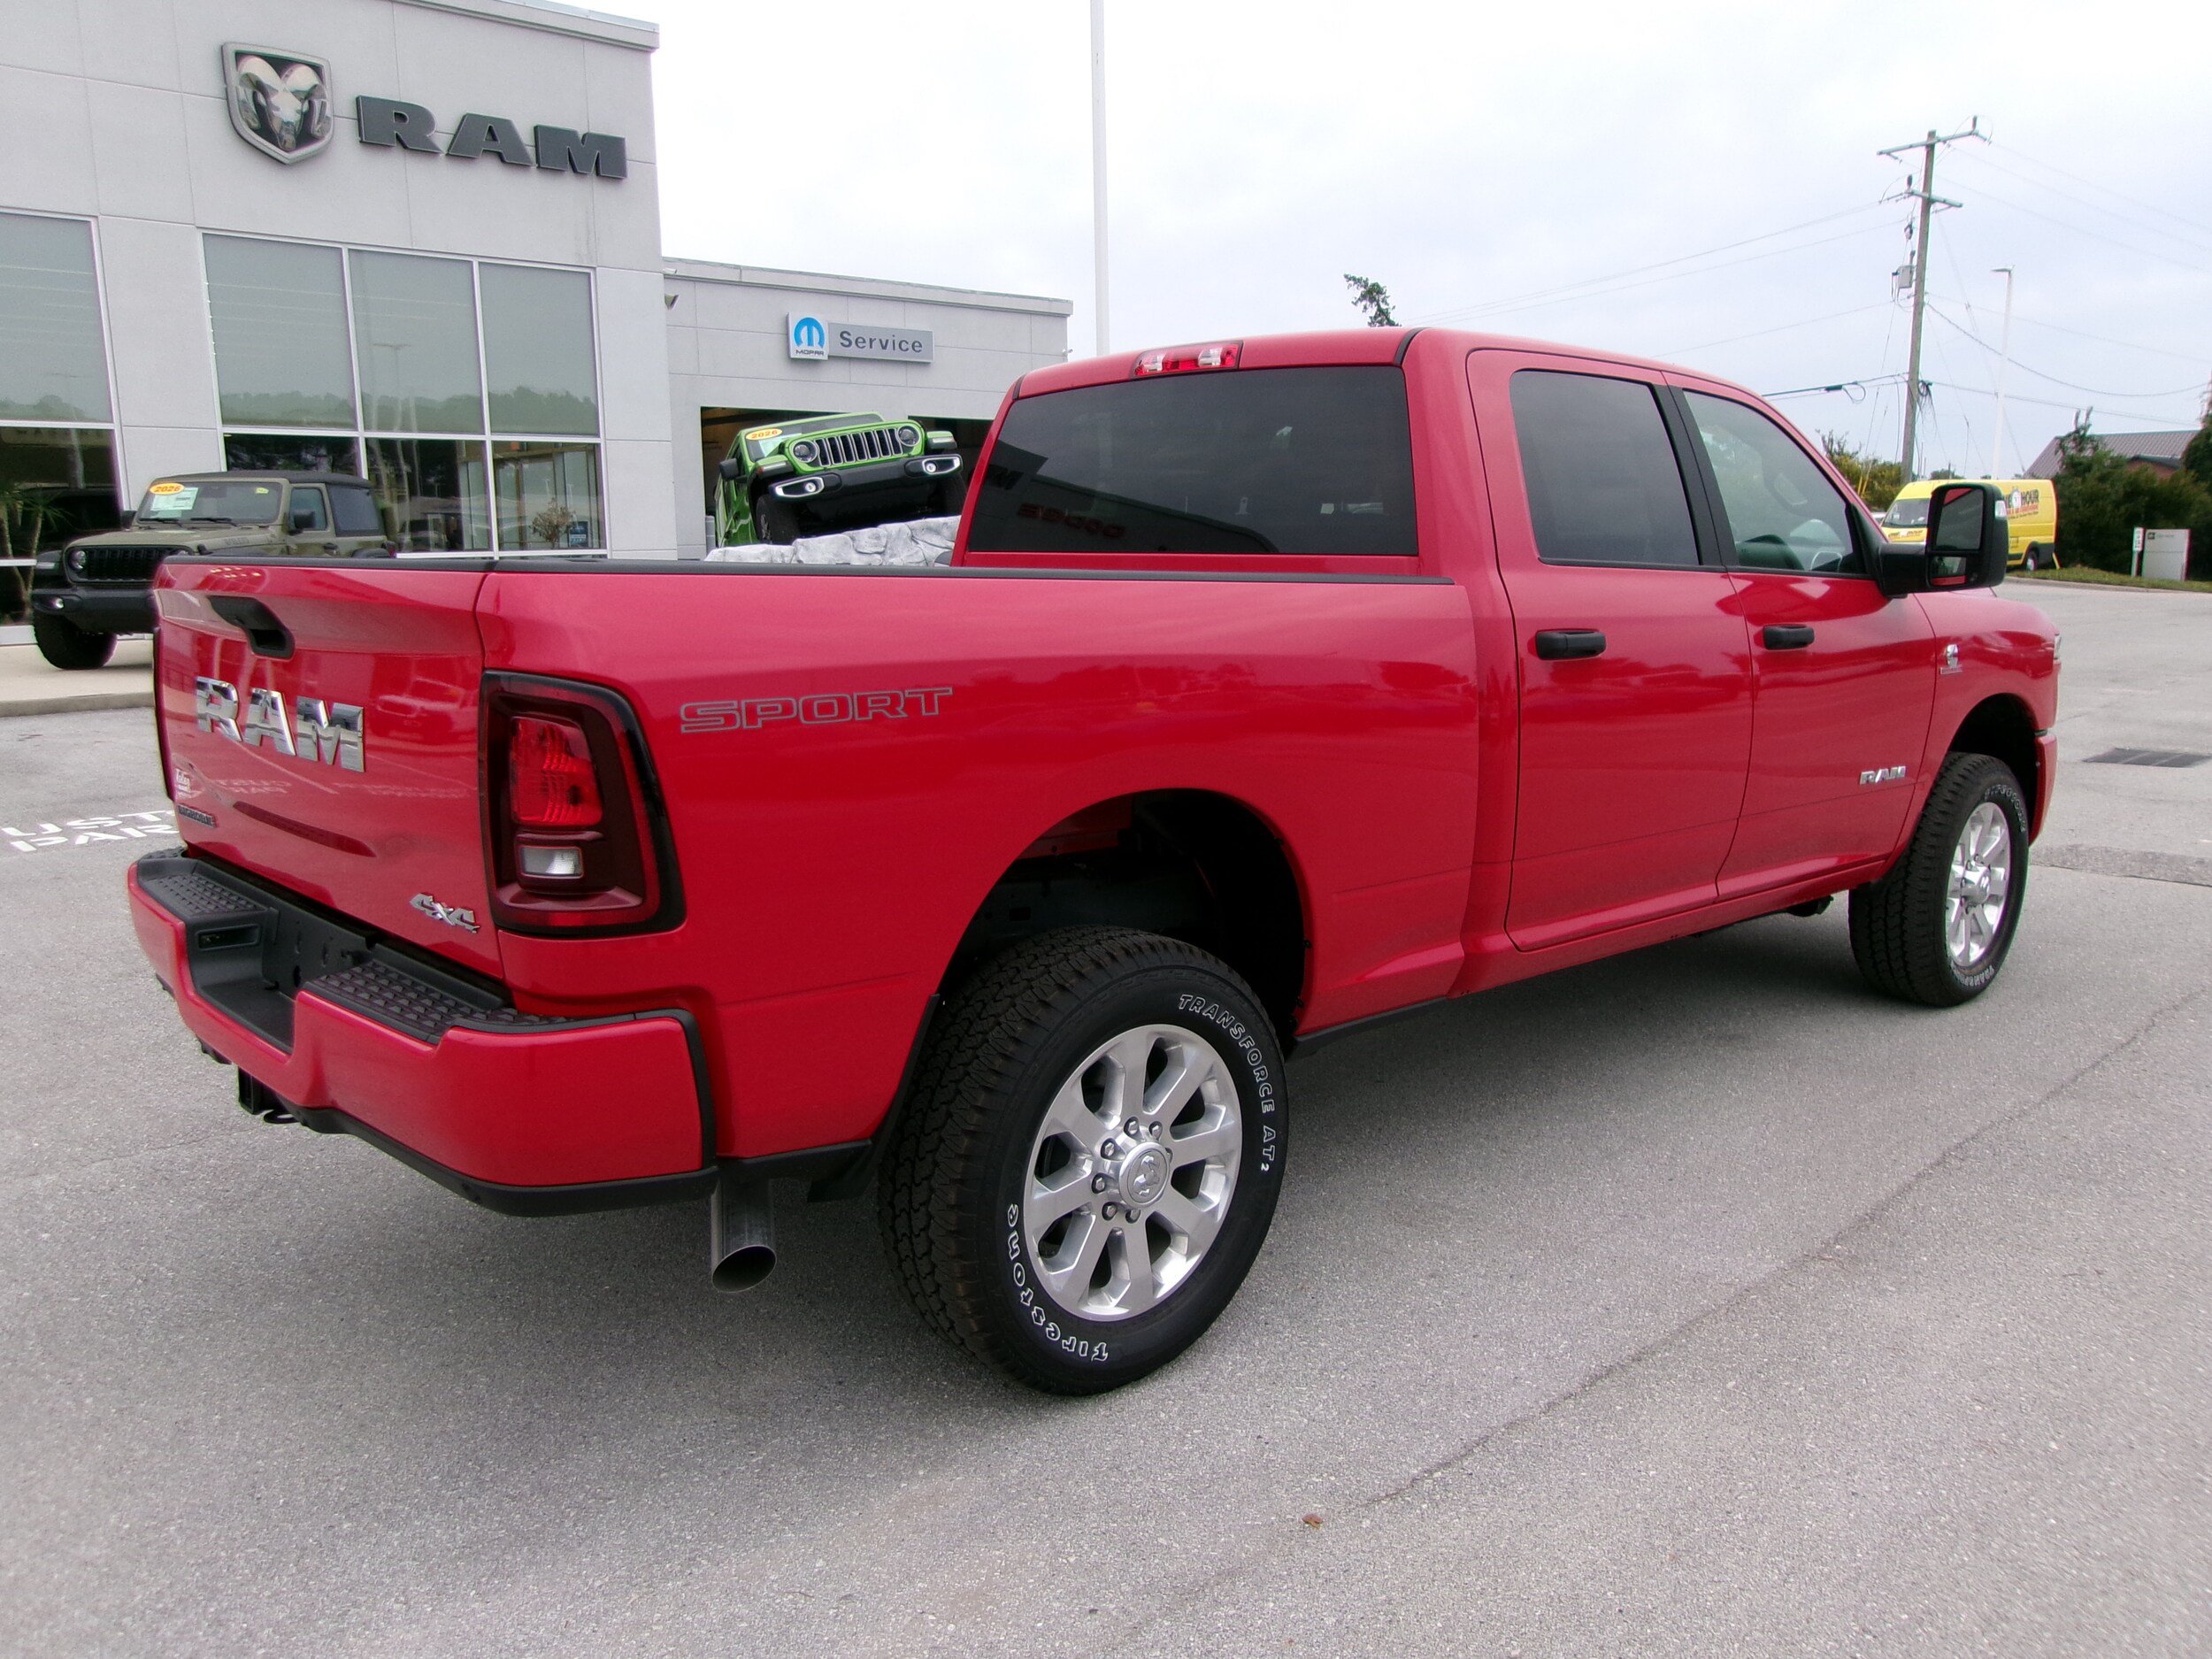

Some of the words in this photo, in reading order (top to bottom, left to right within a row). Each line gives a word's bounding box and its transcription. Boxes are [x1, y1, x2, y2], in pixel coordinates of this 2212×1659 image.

[356, 95, 627, 179] RAM
[839, 330, 923, 353] Service
[750, 429, 779, 439] 2026
[196, 676, 365, 773] RAM
[680, 687, 954, 733] SPORT
[1860, 765, 1907, 786] RAM
[1178, 994, 1276, 1114] TRANSFORCE
[1007, 1203, 1109, 1363] Firestone
